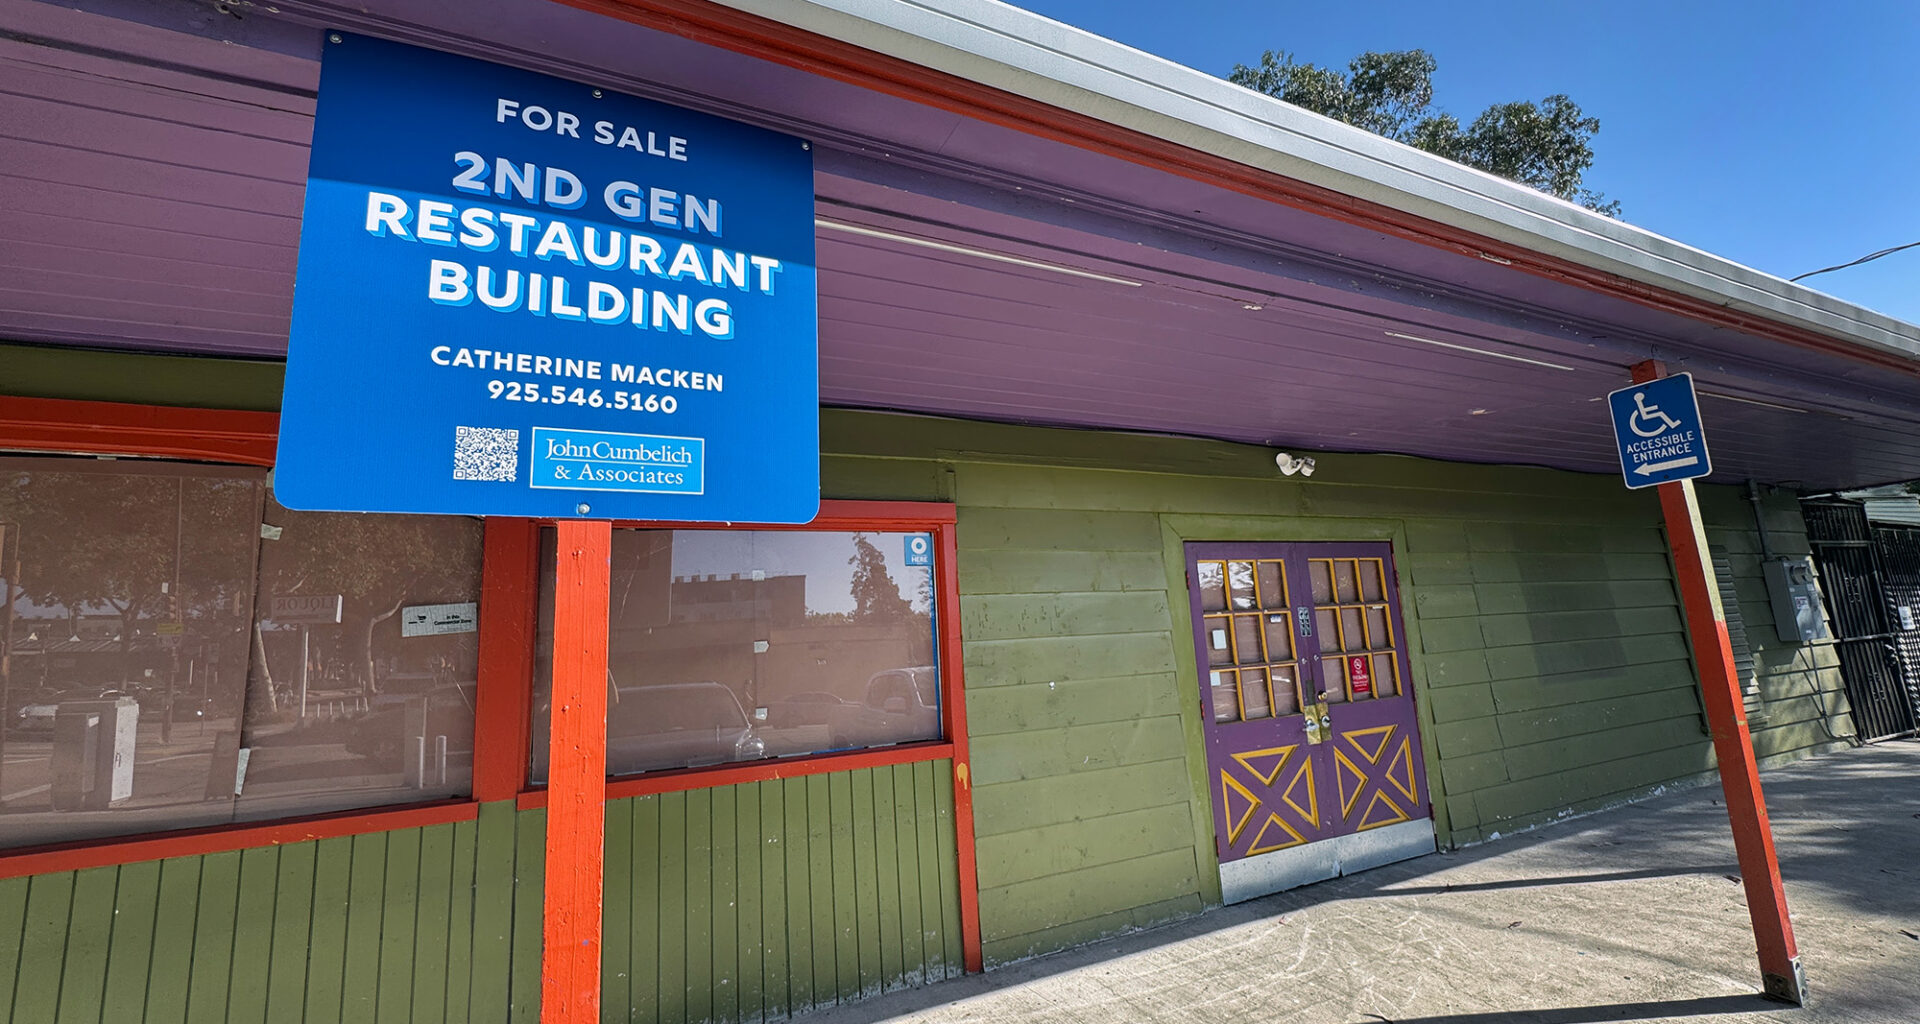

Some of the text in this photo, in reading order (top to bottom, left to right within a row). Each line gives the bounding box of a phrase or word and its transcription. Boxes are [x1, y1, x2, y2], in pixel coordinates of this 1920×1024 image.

[496, 98, 688, 162] FOR SALE
[452, 151, 723, 237] 2ND GEN
[365, 190, 783, 296] RESTAURANT
[428, 259, 735, 339] BUILDING
[430, 345, 724, 392] CATHERINE MACKEN
[487, 379, 678, 414] 925.546.5160
[1626, 430, 1695, 454] ACCESSIBLE
[1632, 442, 1693, 464] ENTRANCE
[554, 463, 684, 485] & Associates
